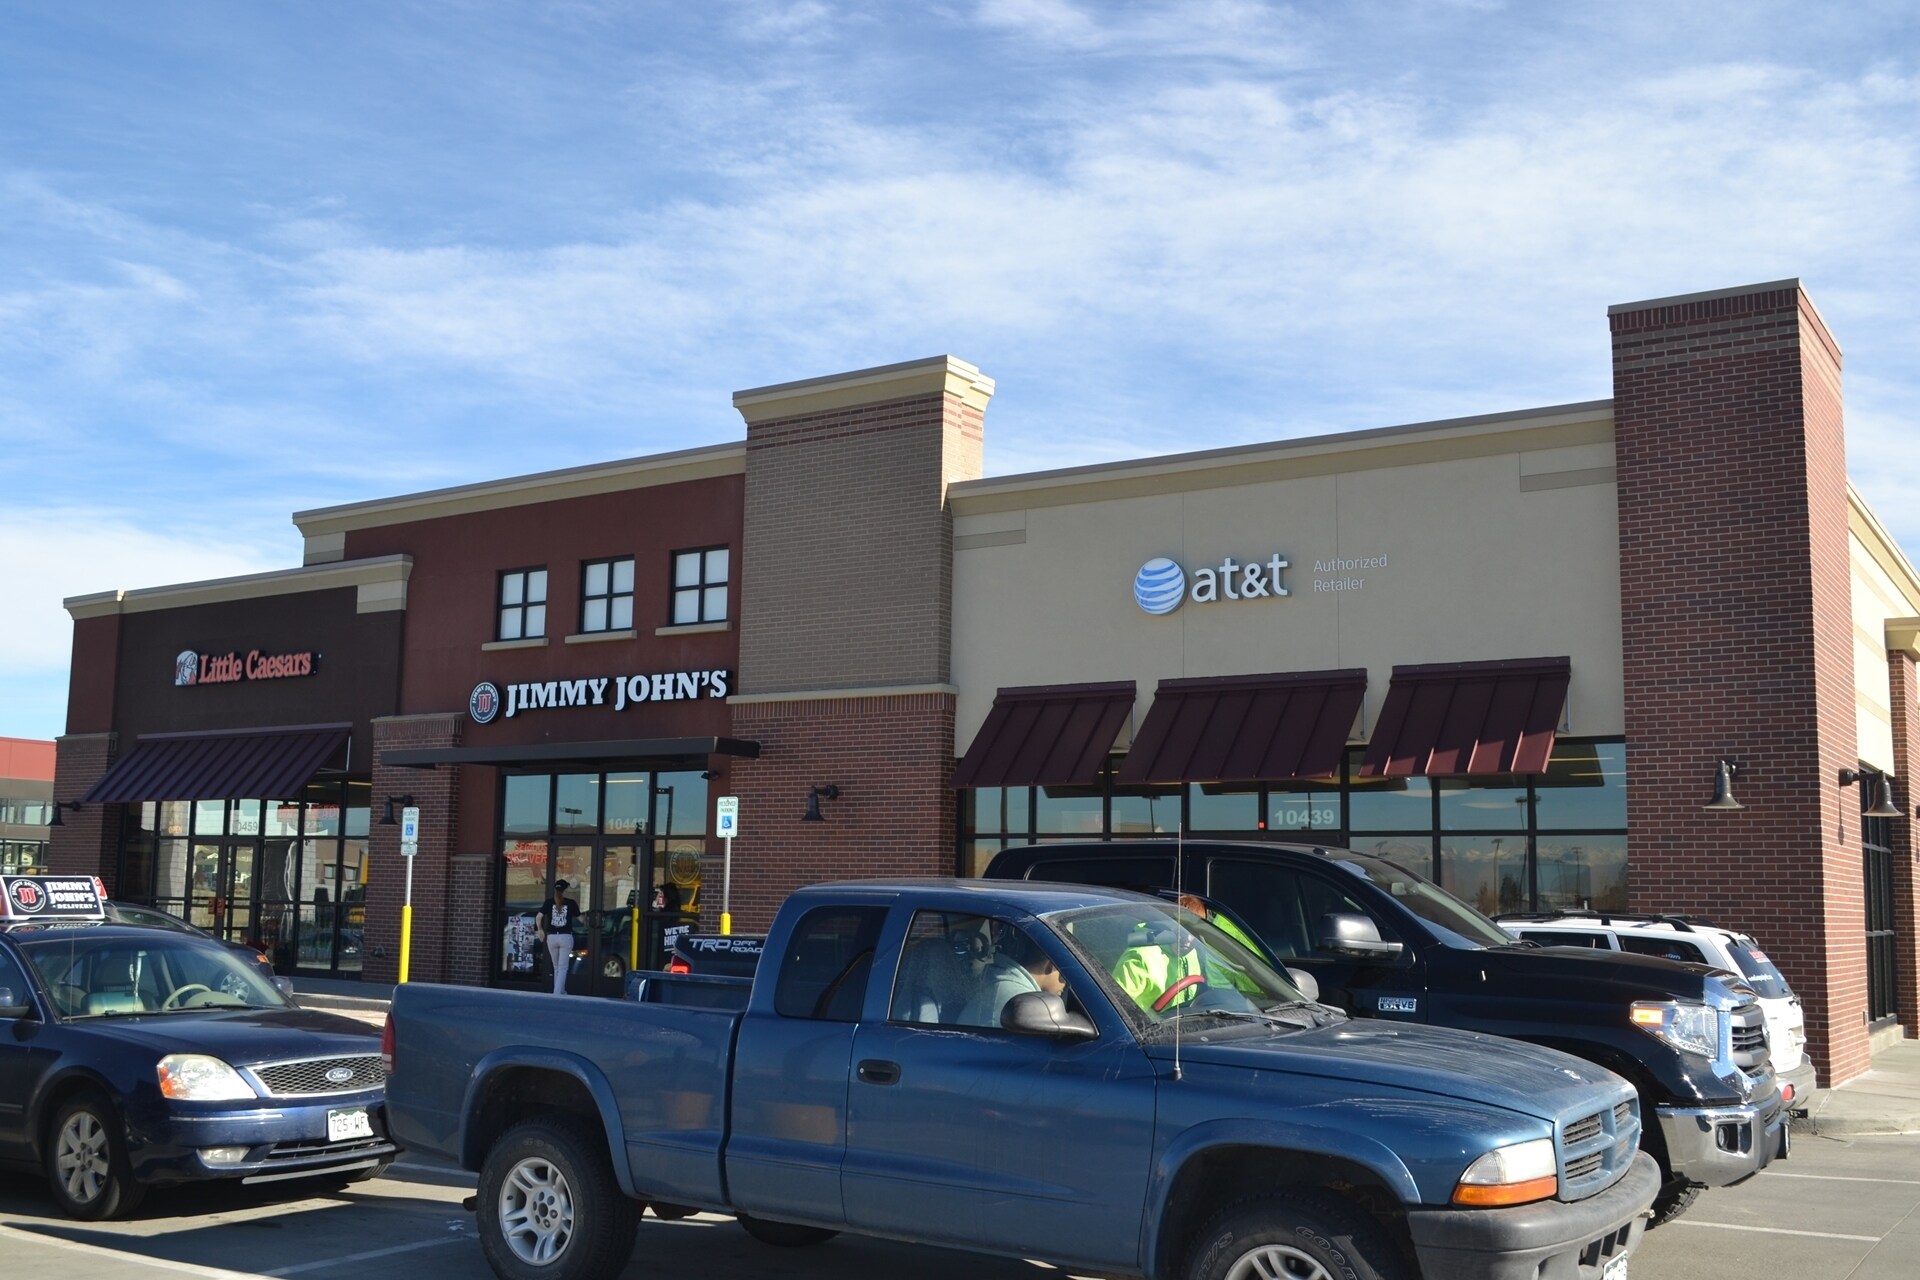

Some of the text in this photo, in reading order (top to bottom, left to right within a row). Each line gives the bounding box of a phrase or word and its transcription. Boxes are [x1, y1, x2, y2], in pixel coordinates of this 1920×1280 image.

[1313, 554, 1388, 573] Authorized
[1191, 553, 1288, 603] at&t
[1313, 577, 1365, 593] Retailer
[198, 650, 311, 683] Little Caesars
[506, 670, 727, 717] JIMMY JOHN'S
[608, 818, 645, 830] 10449
[1274, 809, 1335, 825] 10439
[506, 852, 548, 864] DELIVER
[45, 882, 91, 892] JIMMY
[48, 892, 95, 904] JOHN'S
[664, 925, 690, 936] WE'RE
[689, 939, 731, 952] TRD
[332, 1070, 347, 1079] Ford
[331, 1116, 366, 1132] 725-WF
